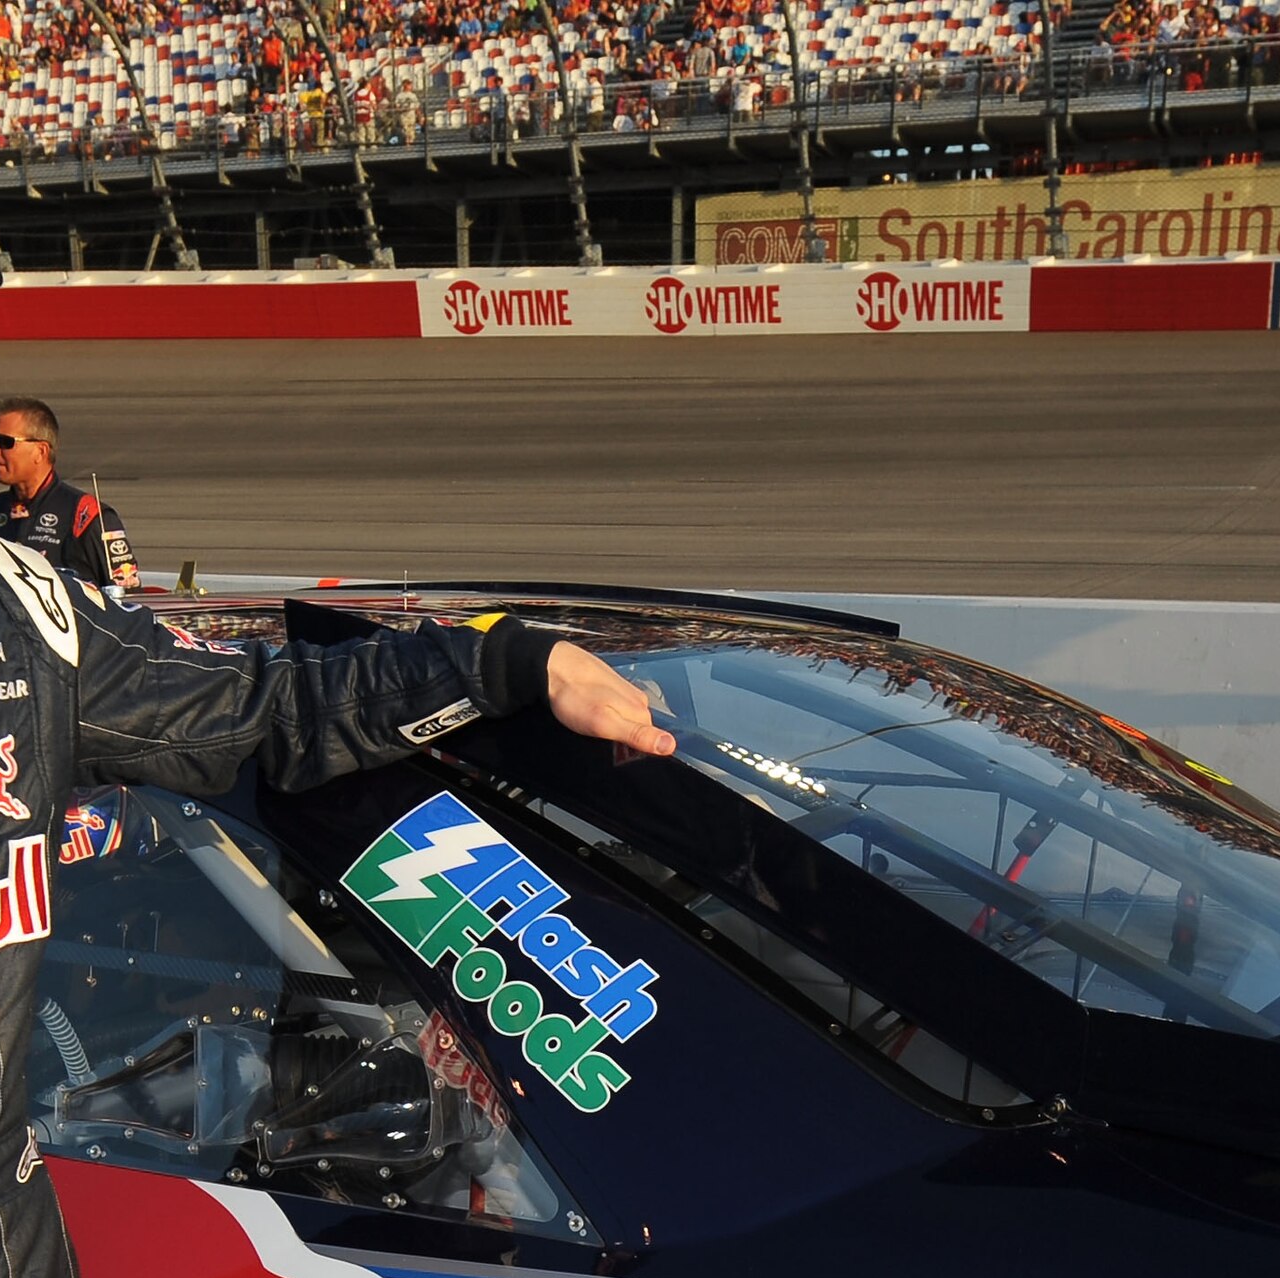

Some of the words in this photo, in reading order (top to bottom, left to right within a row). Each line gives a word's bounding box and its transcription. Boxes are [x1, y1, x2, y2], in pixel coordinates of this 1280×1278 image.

[444, 281, 573, 334] SHOWTIME
[644, 277, 782, 333] SHOWTIME
[856, 272, 1004, 331] SHOWTIME
[59, 826, 96, 864] ull
[467, 855, 660, 1044] Flash
[415, 897, 632, 1113] Foods
